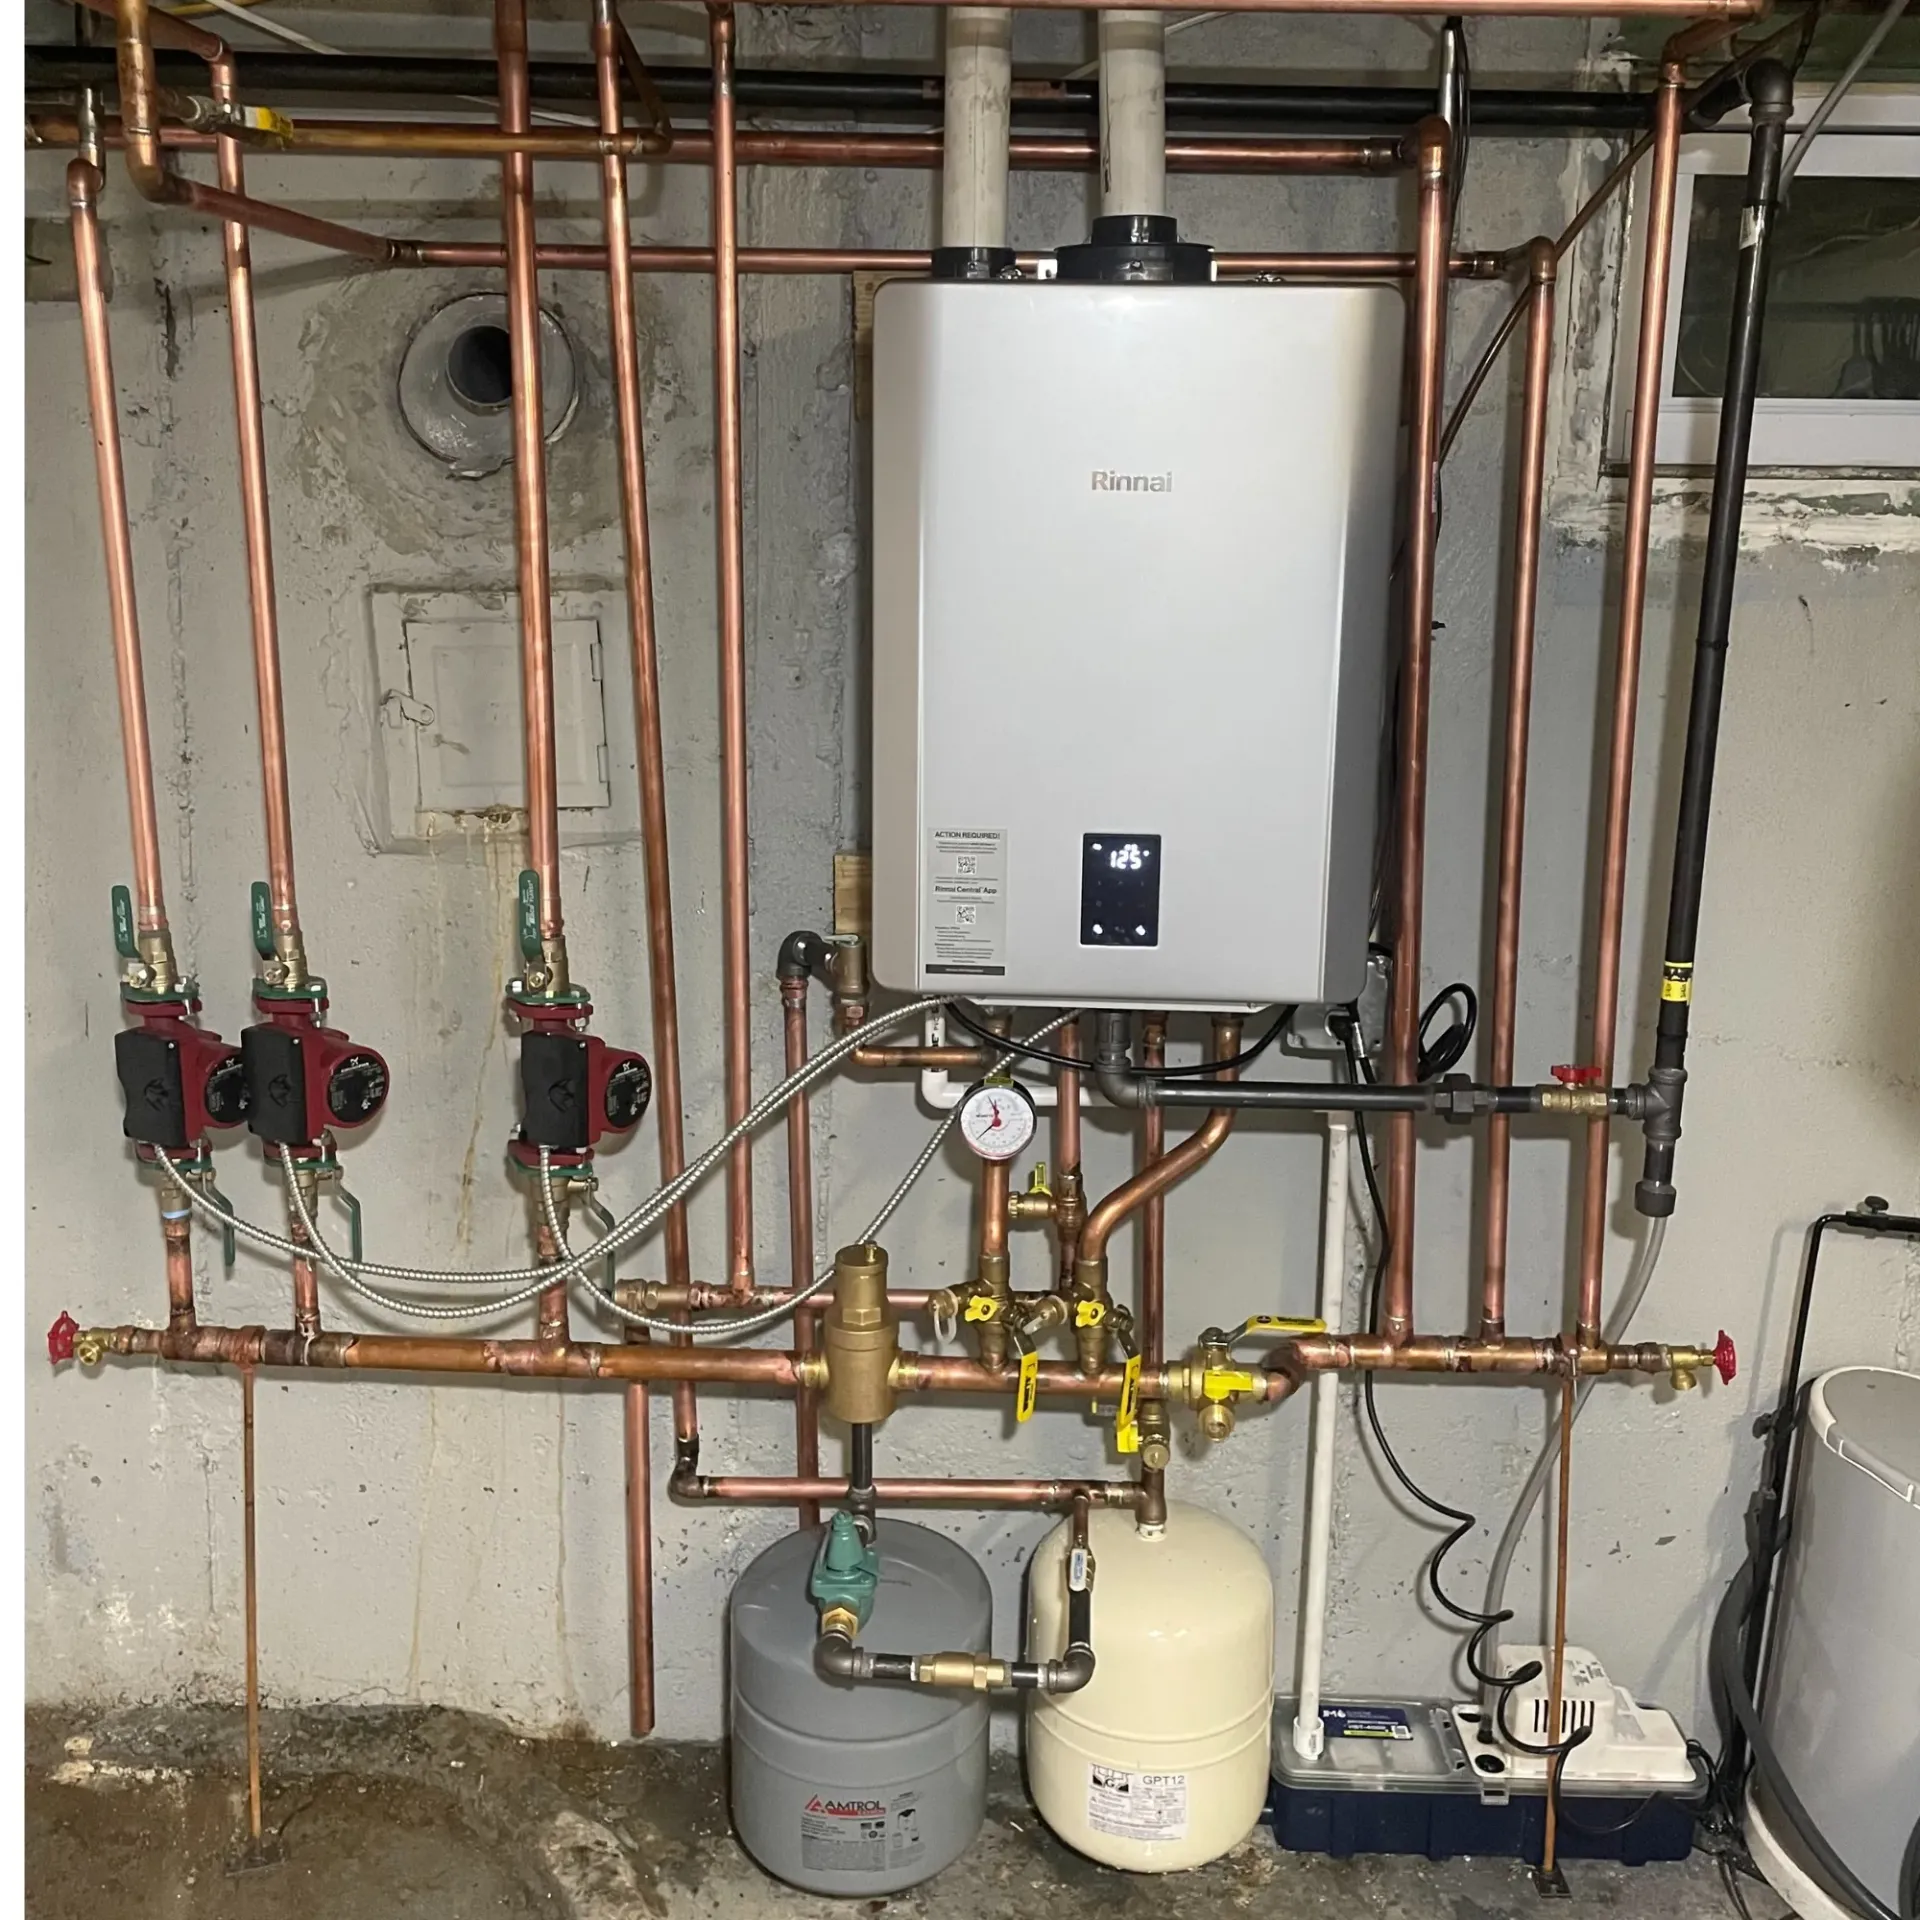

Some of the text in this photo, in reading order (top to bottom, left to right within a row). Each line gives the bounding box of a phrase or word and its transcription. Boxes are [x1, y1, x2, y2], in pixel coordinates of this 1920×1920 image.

[1091, 470, 1172, 492] Rinnai
[1142, 1775, 1185, 1785] GPT12
[824, 1800, 884, 1811] AMTROL
